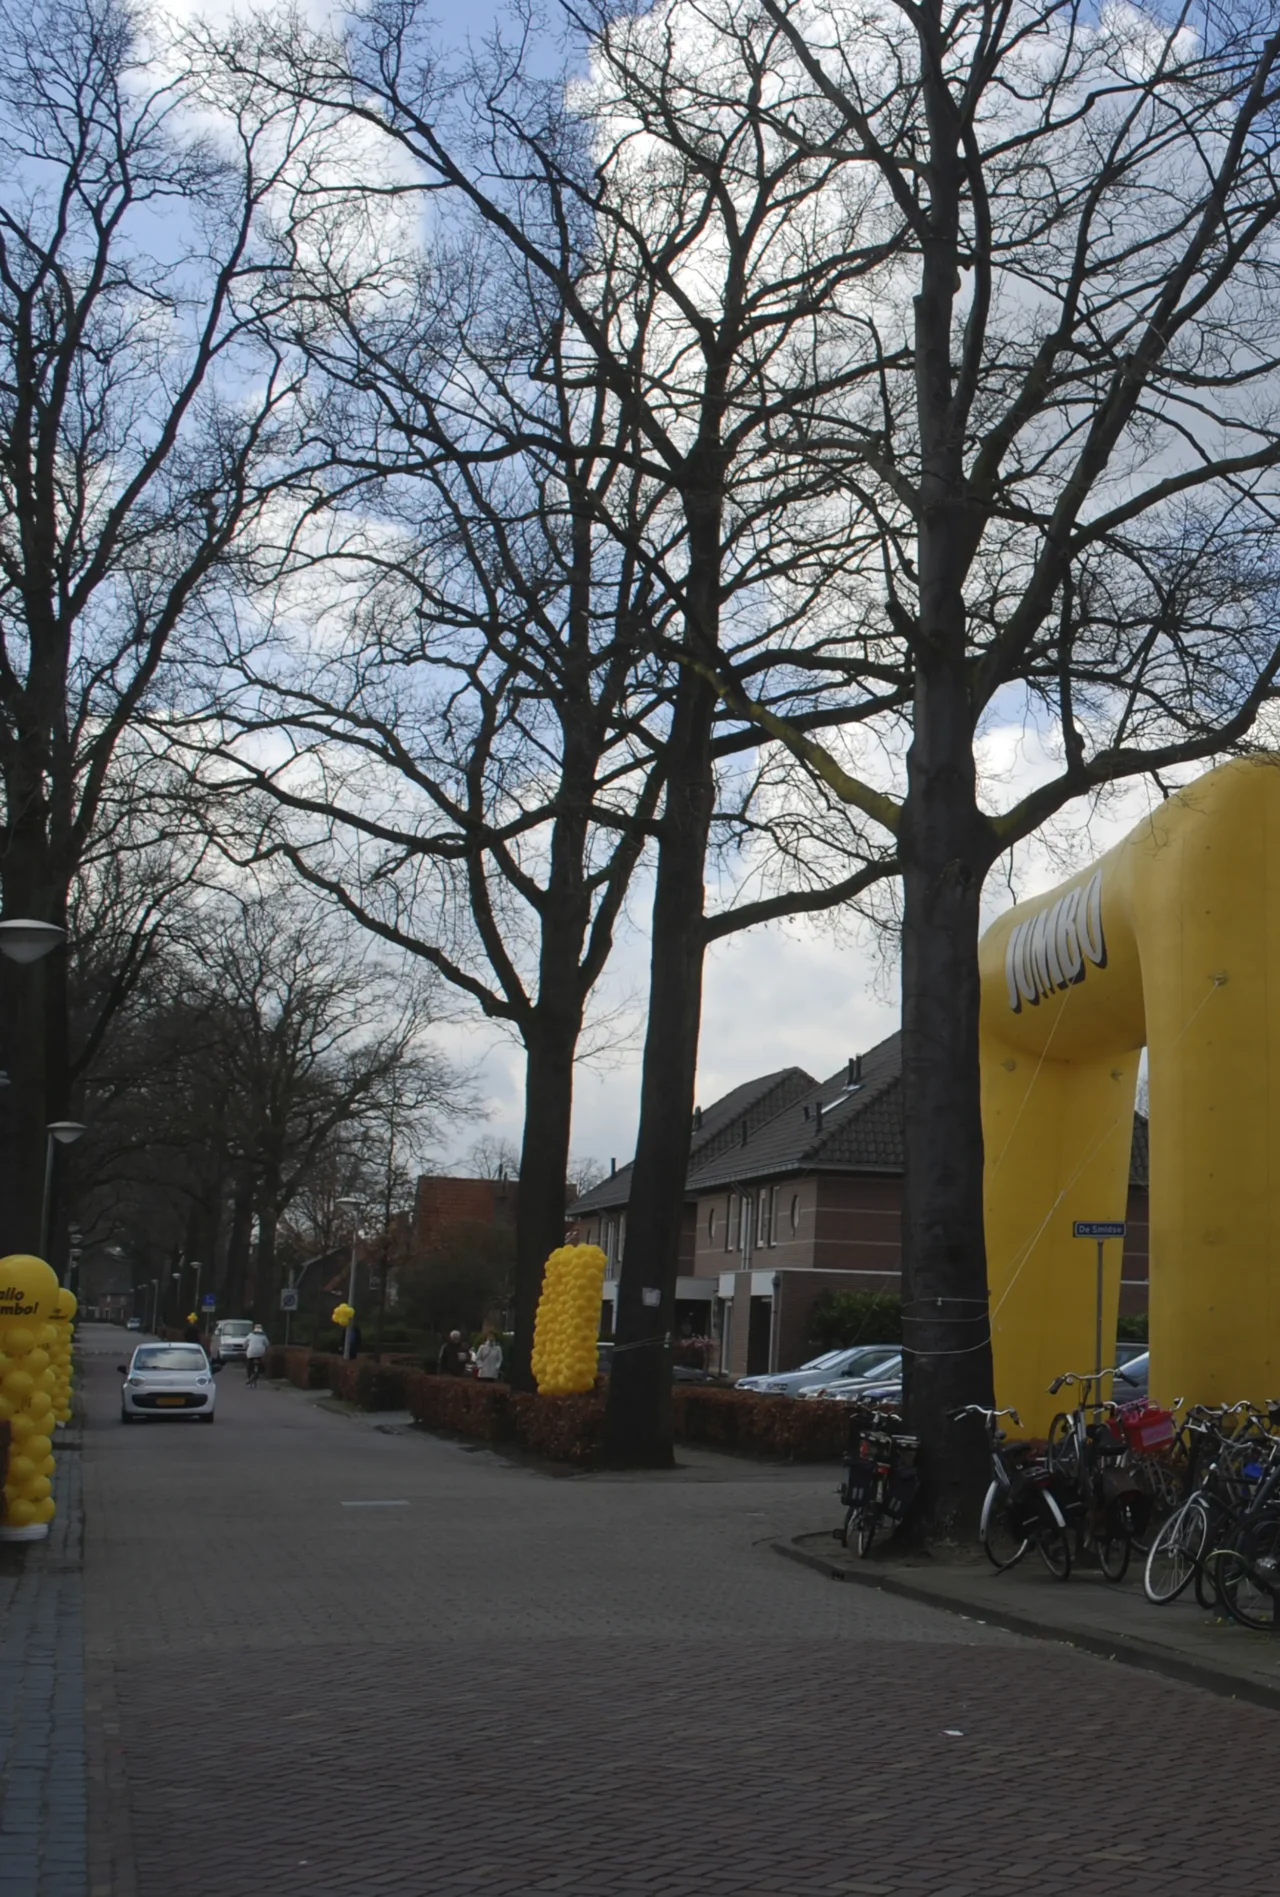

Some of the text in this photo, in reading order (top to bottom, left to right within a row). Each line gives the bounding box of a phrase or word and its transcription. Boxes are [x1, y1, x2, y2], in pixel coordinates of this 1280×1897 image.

[1005, 867, 1108, 1014] JUMBO
[0, 1287, 25, 1301] allo
[0, 1302, 39, 1316] mbo!
